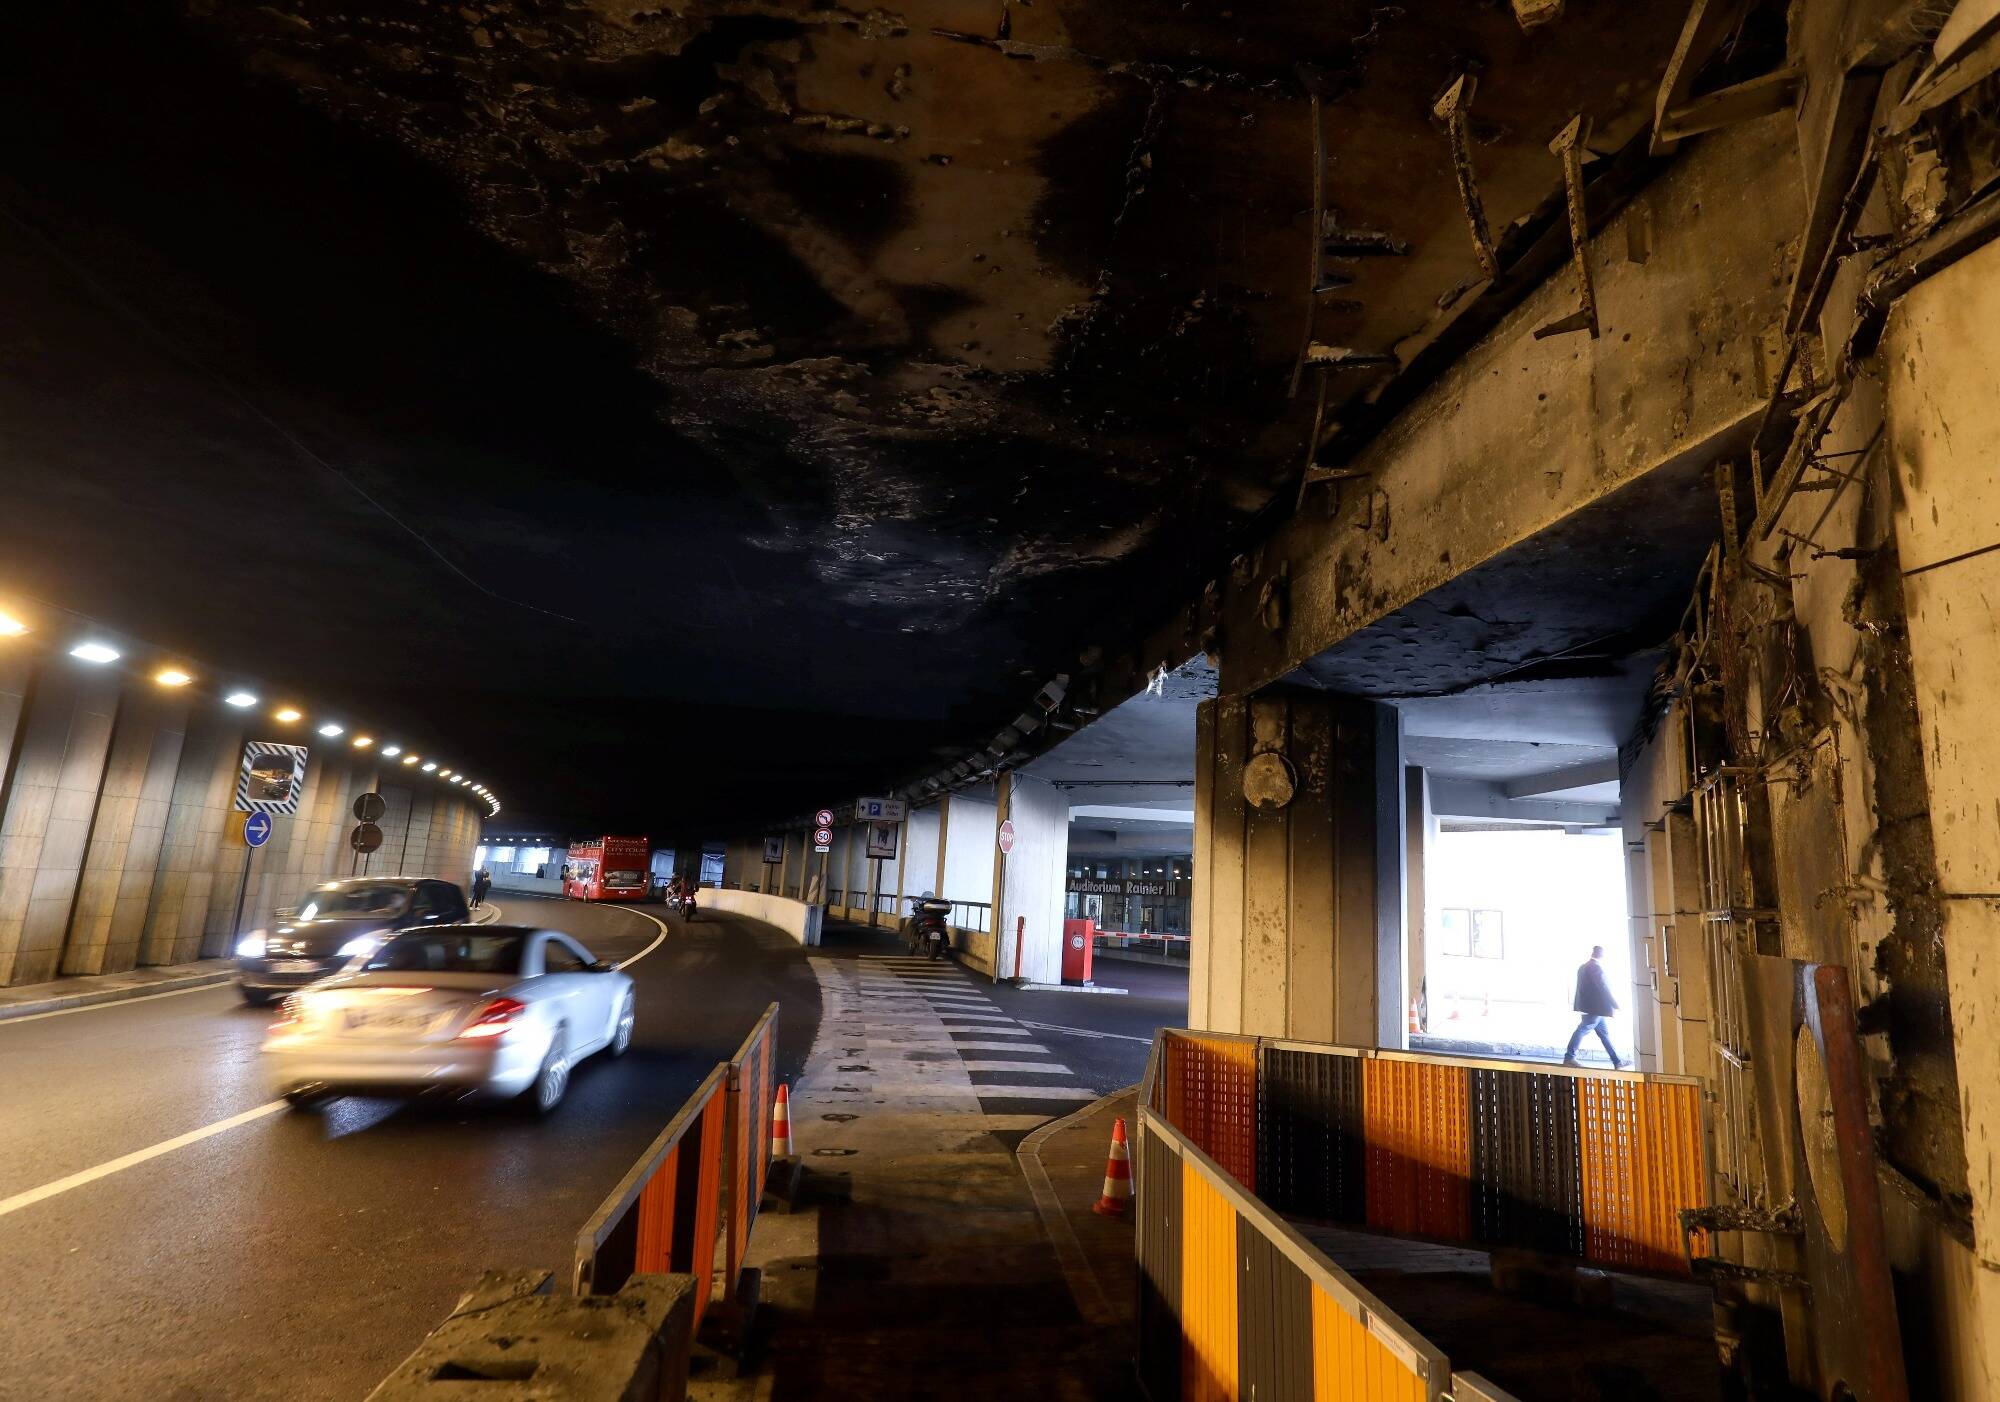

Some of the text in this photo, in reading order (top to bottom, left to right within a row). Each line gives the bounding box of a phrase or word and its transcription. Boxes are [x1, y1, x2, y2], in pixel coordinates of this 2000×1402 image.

[871, 804, 879, 813] P
[1001, 832, 1013, 842] STOP
[1069, 879, 1176, 896] Auditorium Rainier III
